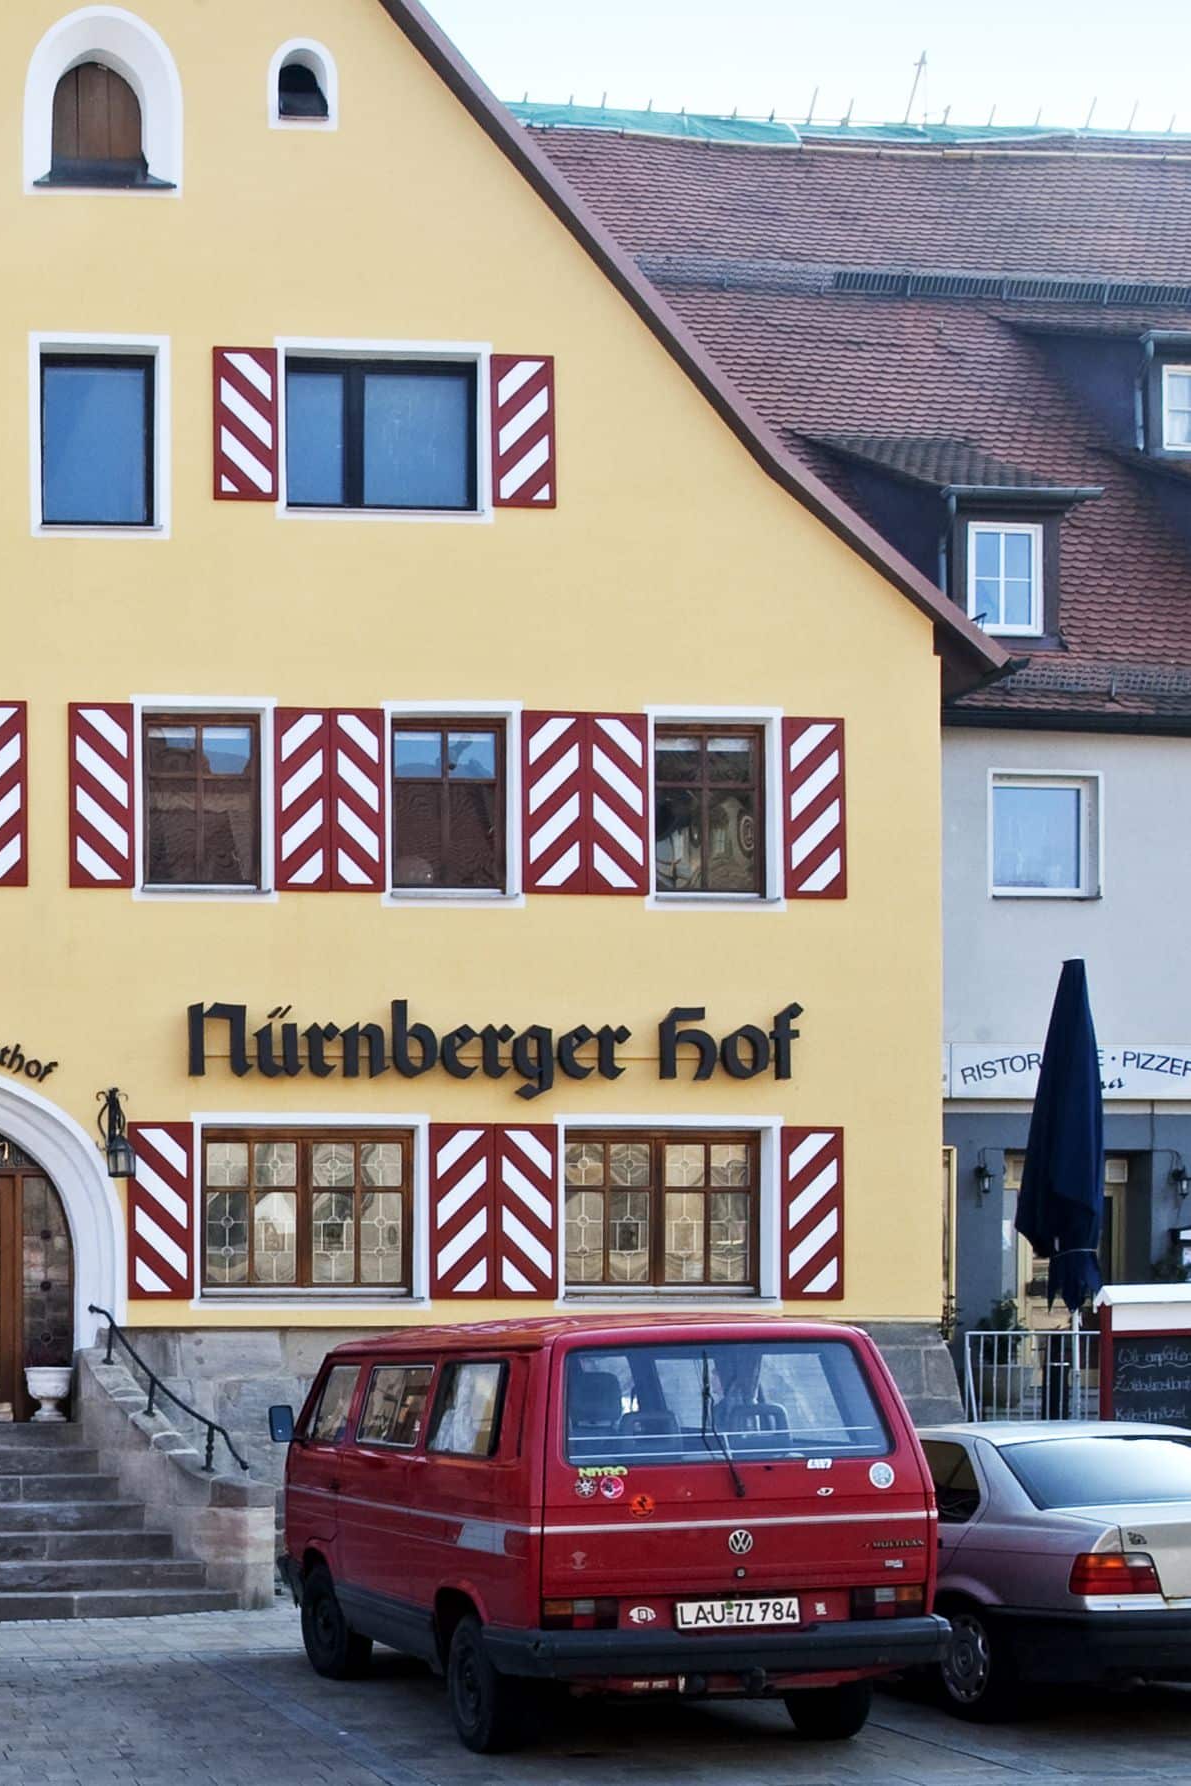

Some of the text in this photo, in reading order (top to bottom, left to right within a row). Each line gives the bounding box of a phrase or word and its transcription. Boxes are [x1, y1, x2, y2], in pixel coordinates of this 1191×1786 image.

[187, 999, 805, 1100] Nürnberger Hof
[759, 1600, 797, 1622] 784
